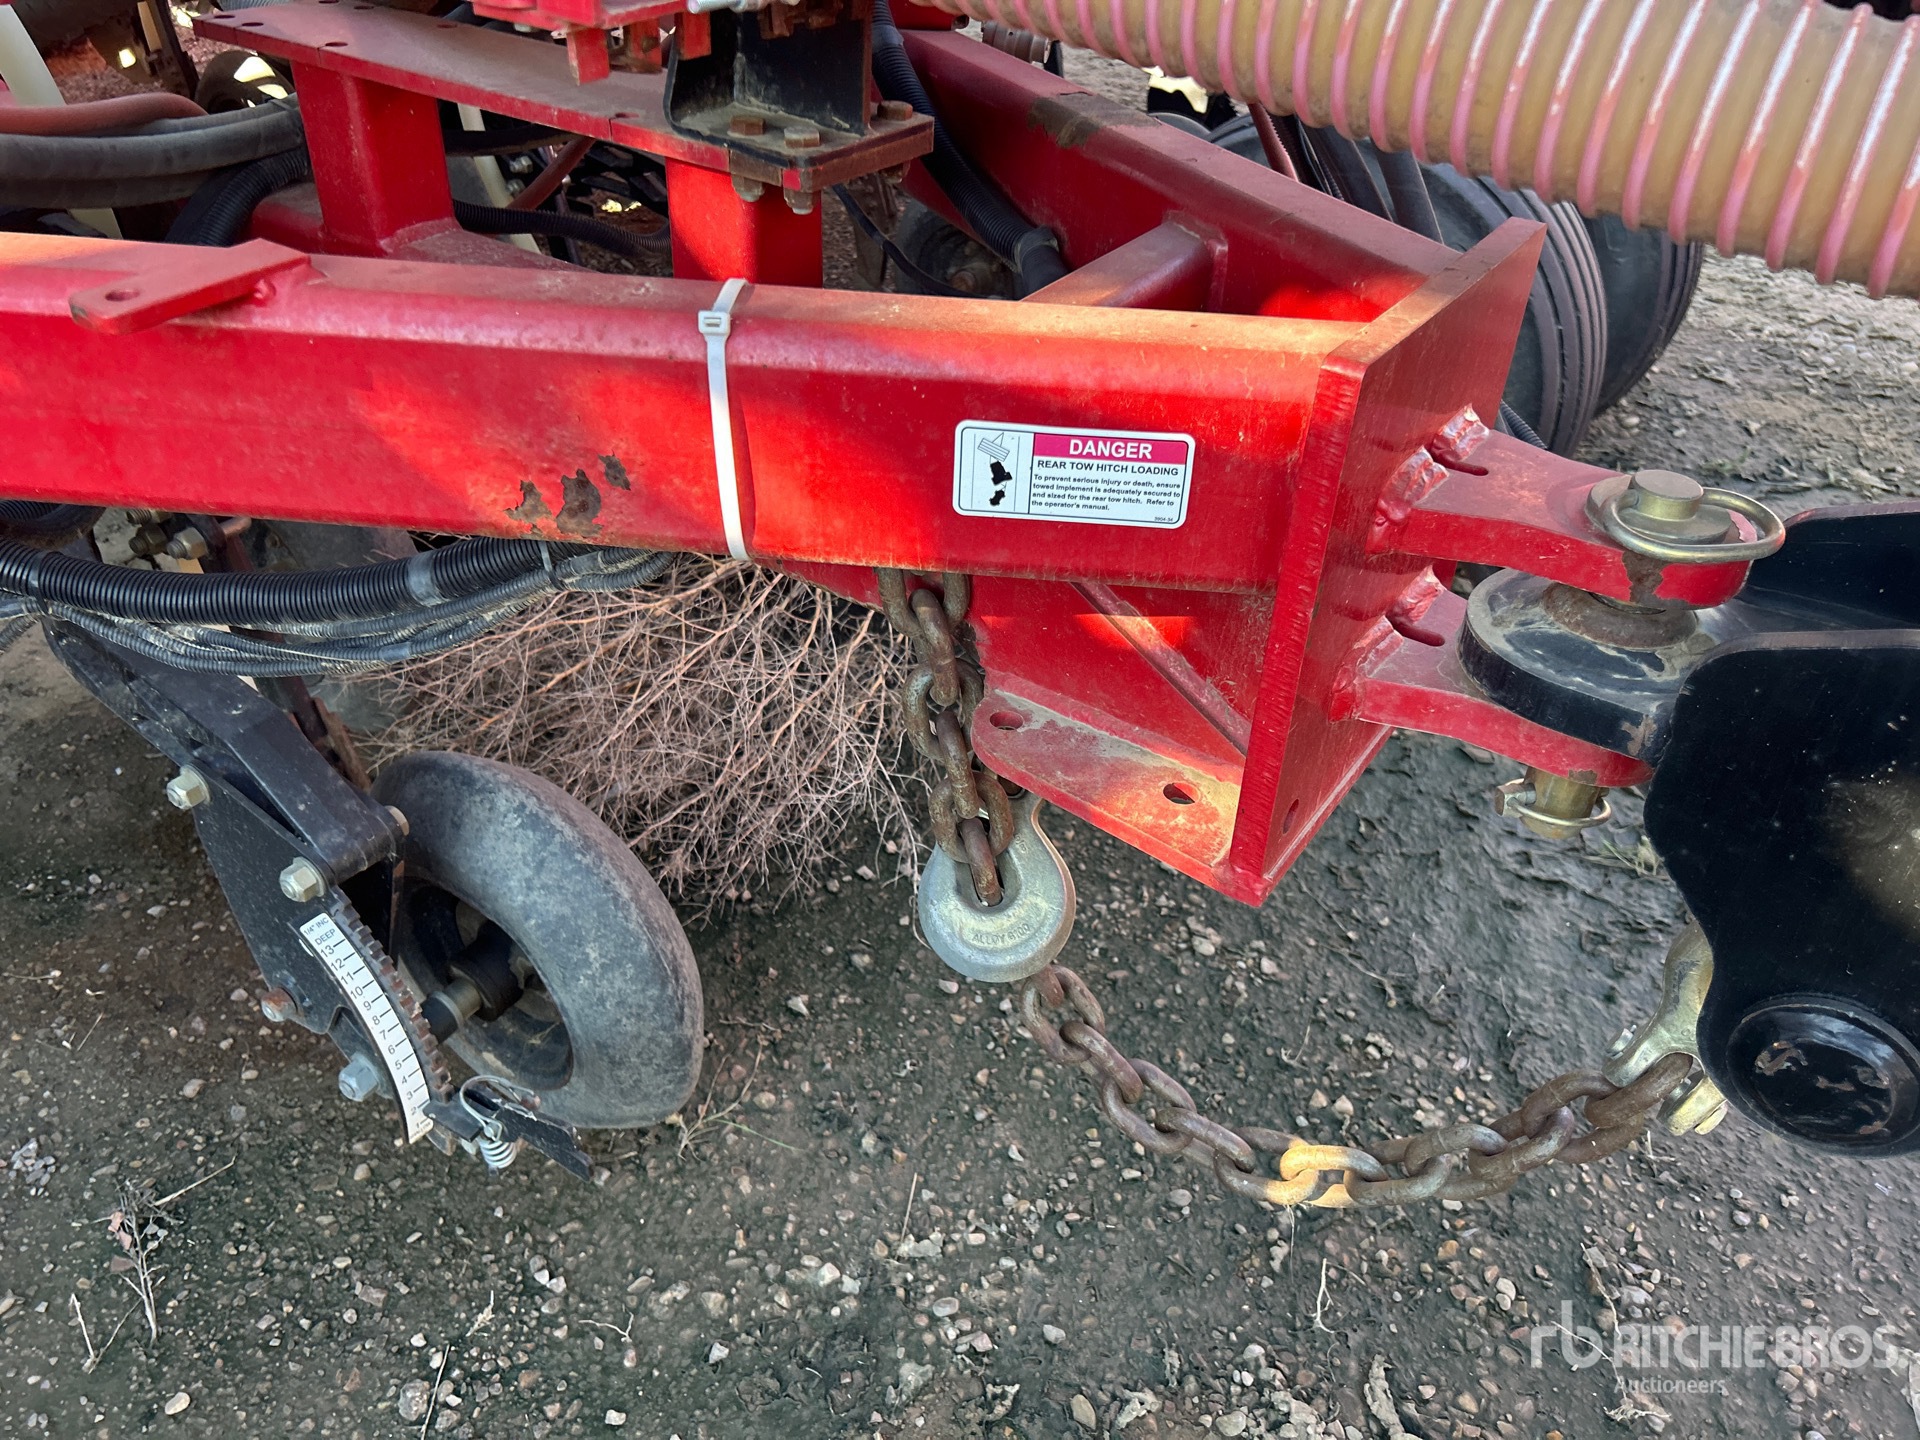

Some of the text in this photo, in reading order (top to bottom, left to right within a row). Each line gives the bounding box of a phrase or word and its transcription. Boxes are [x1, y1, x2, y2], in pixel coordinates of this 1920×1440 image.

[1069, 439, 1152, 459] DANGER
[1037, 460, 1179, 476] REAR TOW HITCH LOADING
[1044, 474, 1071, 483] prevent
[1072, 476, 1099, 484] serious
[1101, 478, 1121, 487] injury
[1132, 480, 1155, 488] death,
[1056, 484, 1093, 492] implement
[1102, 486, 1142, 497] adequately
[1143, 490, 1172, 498] secured
[1082, 503, 1110, 511] manual.
[315, 928, 336, 945] DEEP
[972, 934, 1005, 945] ALLOY
[320, 945, 335, 957] 13
[330, 957, 345, 971] 12
[340, 972, 354, 986] 11
[350, 986, 364, 999] 10
[363, 1000, 372, 1011] 9
[372, 1015, 380, 1026] 8
[379, 1030, 388, 1040] 7
[387, 1044, 395, 1055] 6
[395, 1059, 403, 1070] 5
[401, 1075, 408, 1085] 4
[406, 1091, 413, 1100] 3
[411, 1106, 417, 1116] 2
